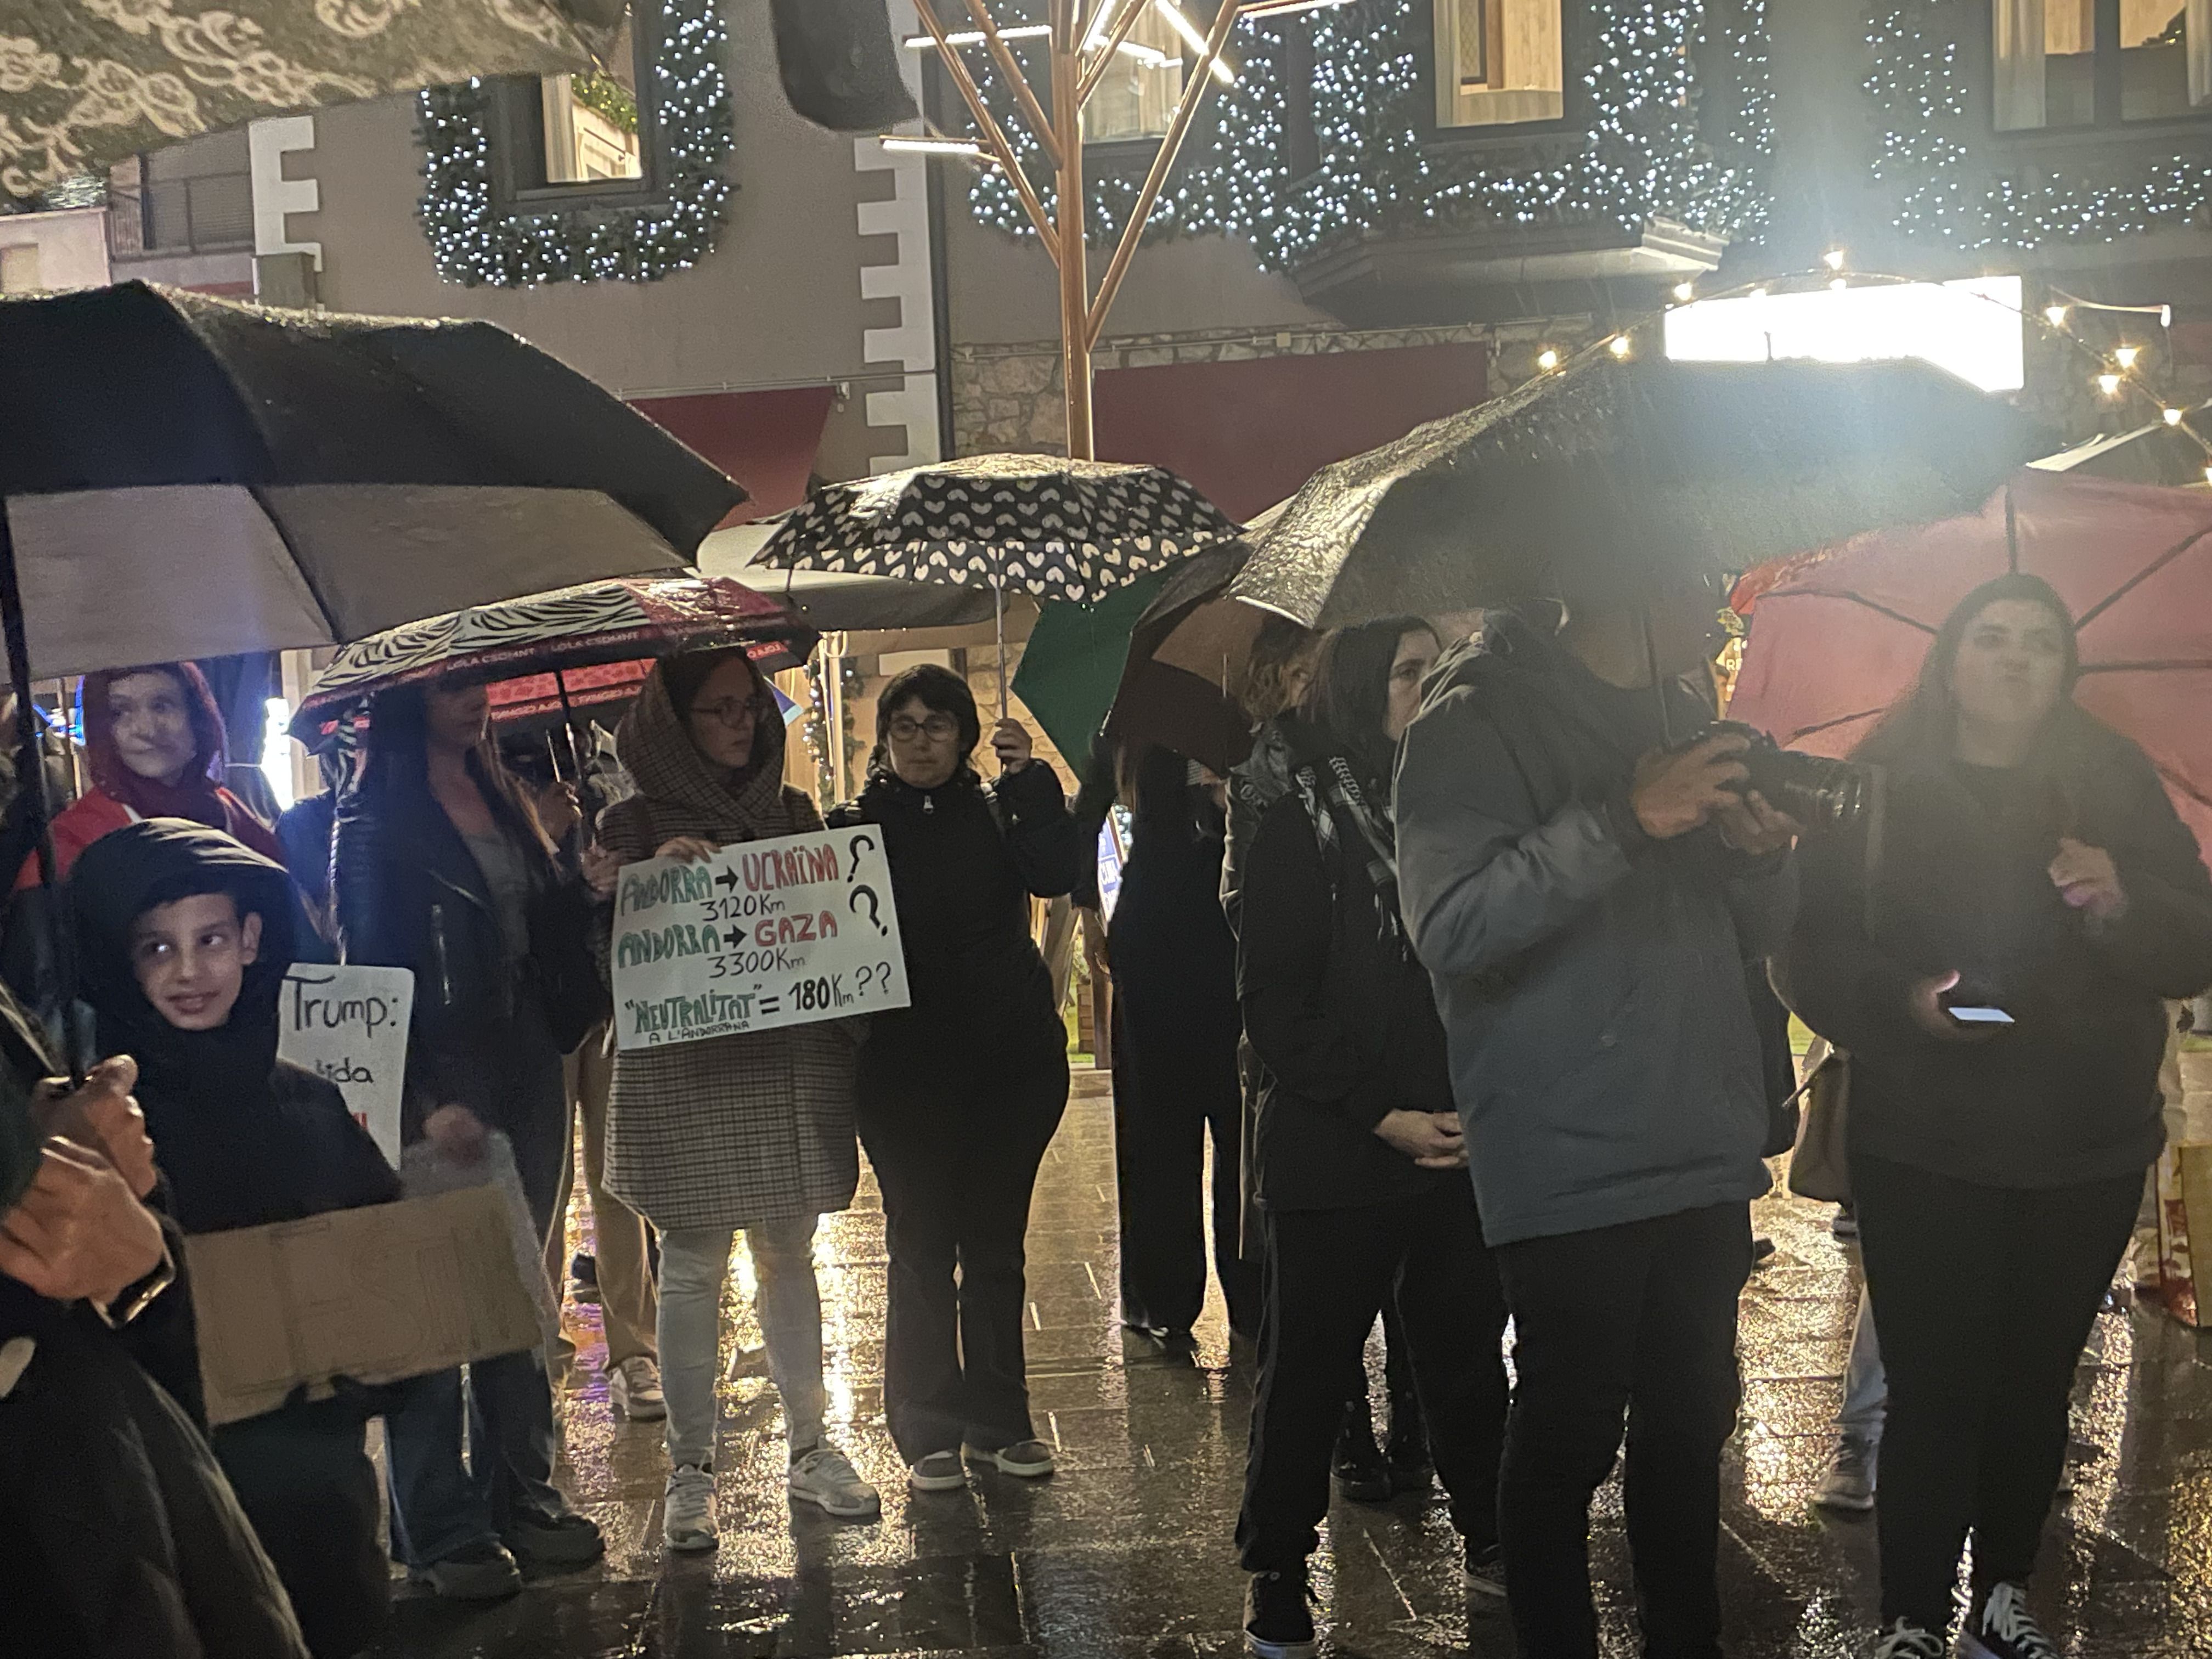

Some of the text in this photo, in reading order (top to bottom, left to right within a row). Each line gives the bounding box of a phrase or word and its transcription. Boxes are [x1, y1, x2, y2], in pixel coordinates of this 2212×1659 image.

[620, 865, 713, 917] ANDORRA
[618, 924, 721, 969] ANDORRA
[754, 910, 838, 947] GAZA
[282, 974, 398, 1039] Trump:
[649, 1032, 661, 1045] A
